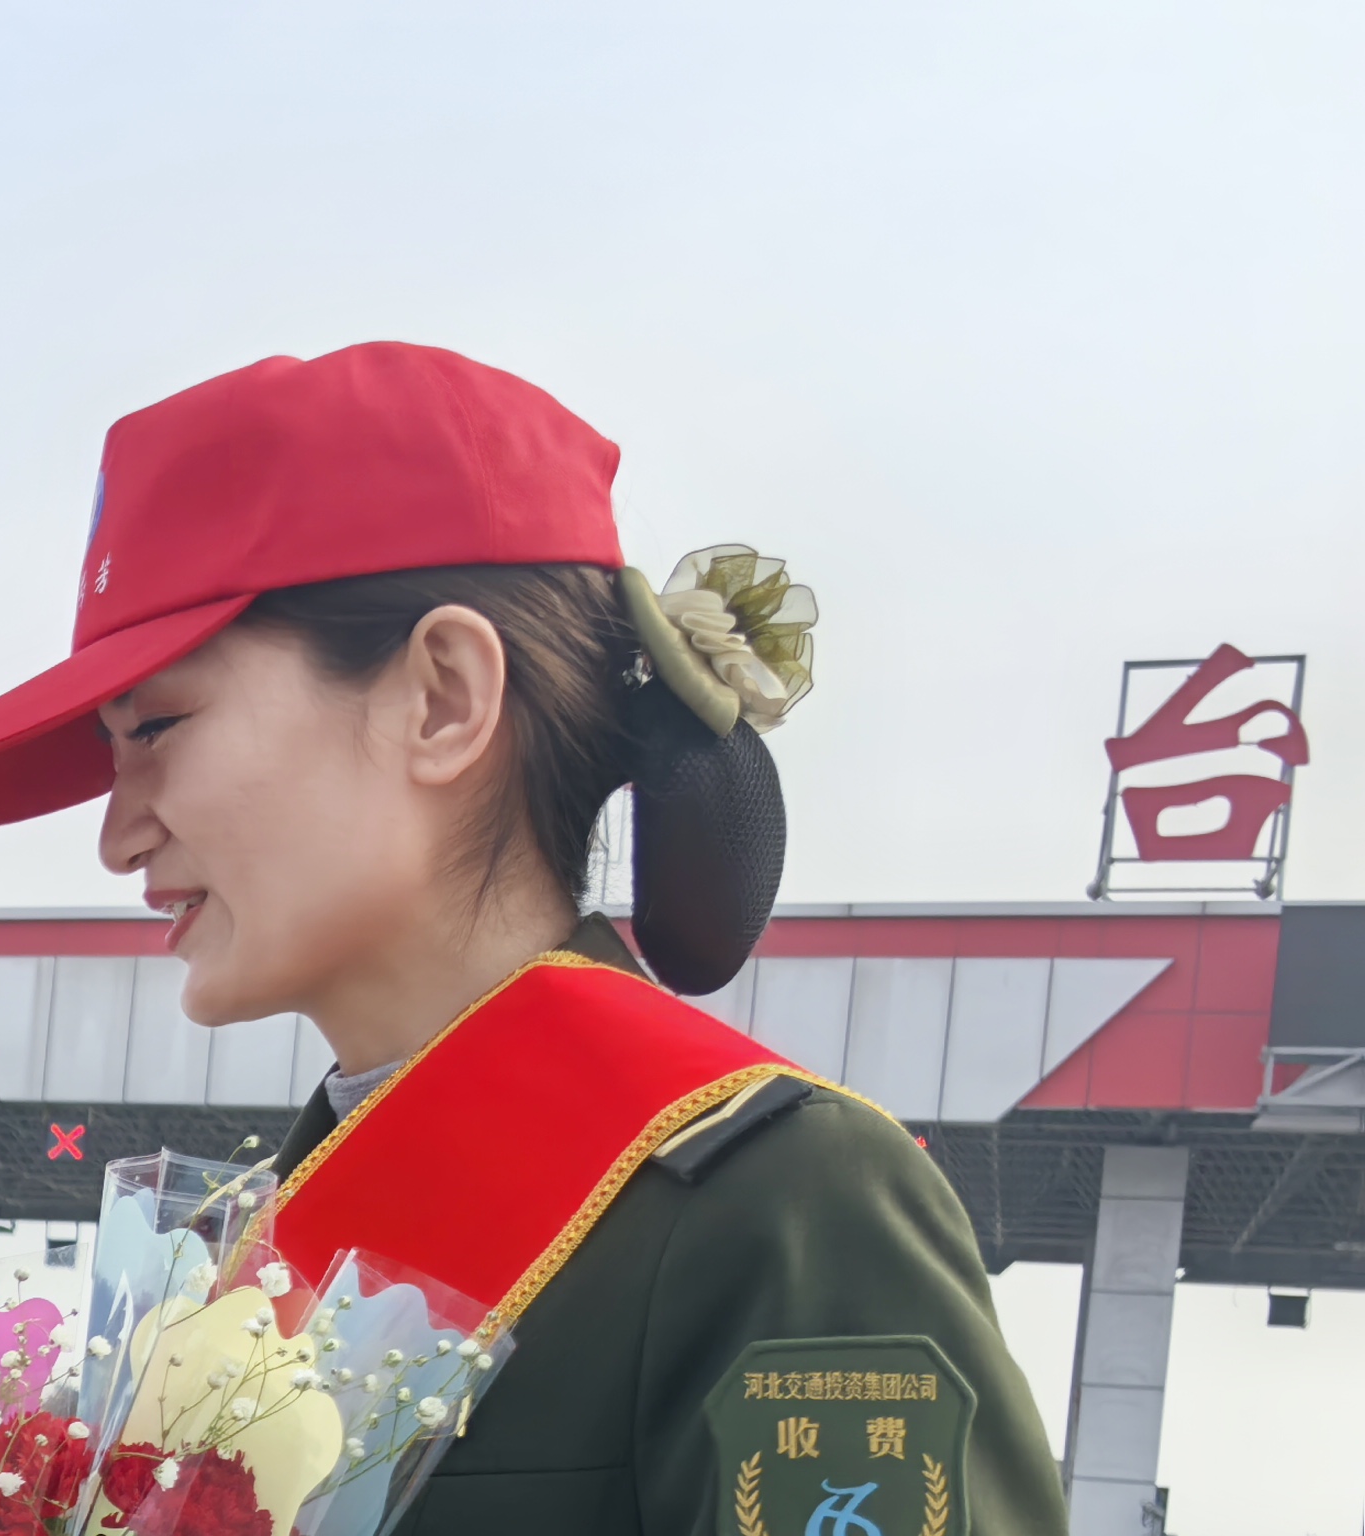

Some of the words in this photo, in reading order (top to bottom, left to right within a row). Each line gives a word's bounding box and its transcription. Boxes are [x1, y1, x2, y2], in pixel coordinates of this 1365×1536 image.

[1105, 643, 1309, 861] 台
[743, 1371, 938, 1401] 河北交通投资集团公司
[776, 1416, 906, 1460] 收费
